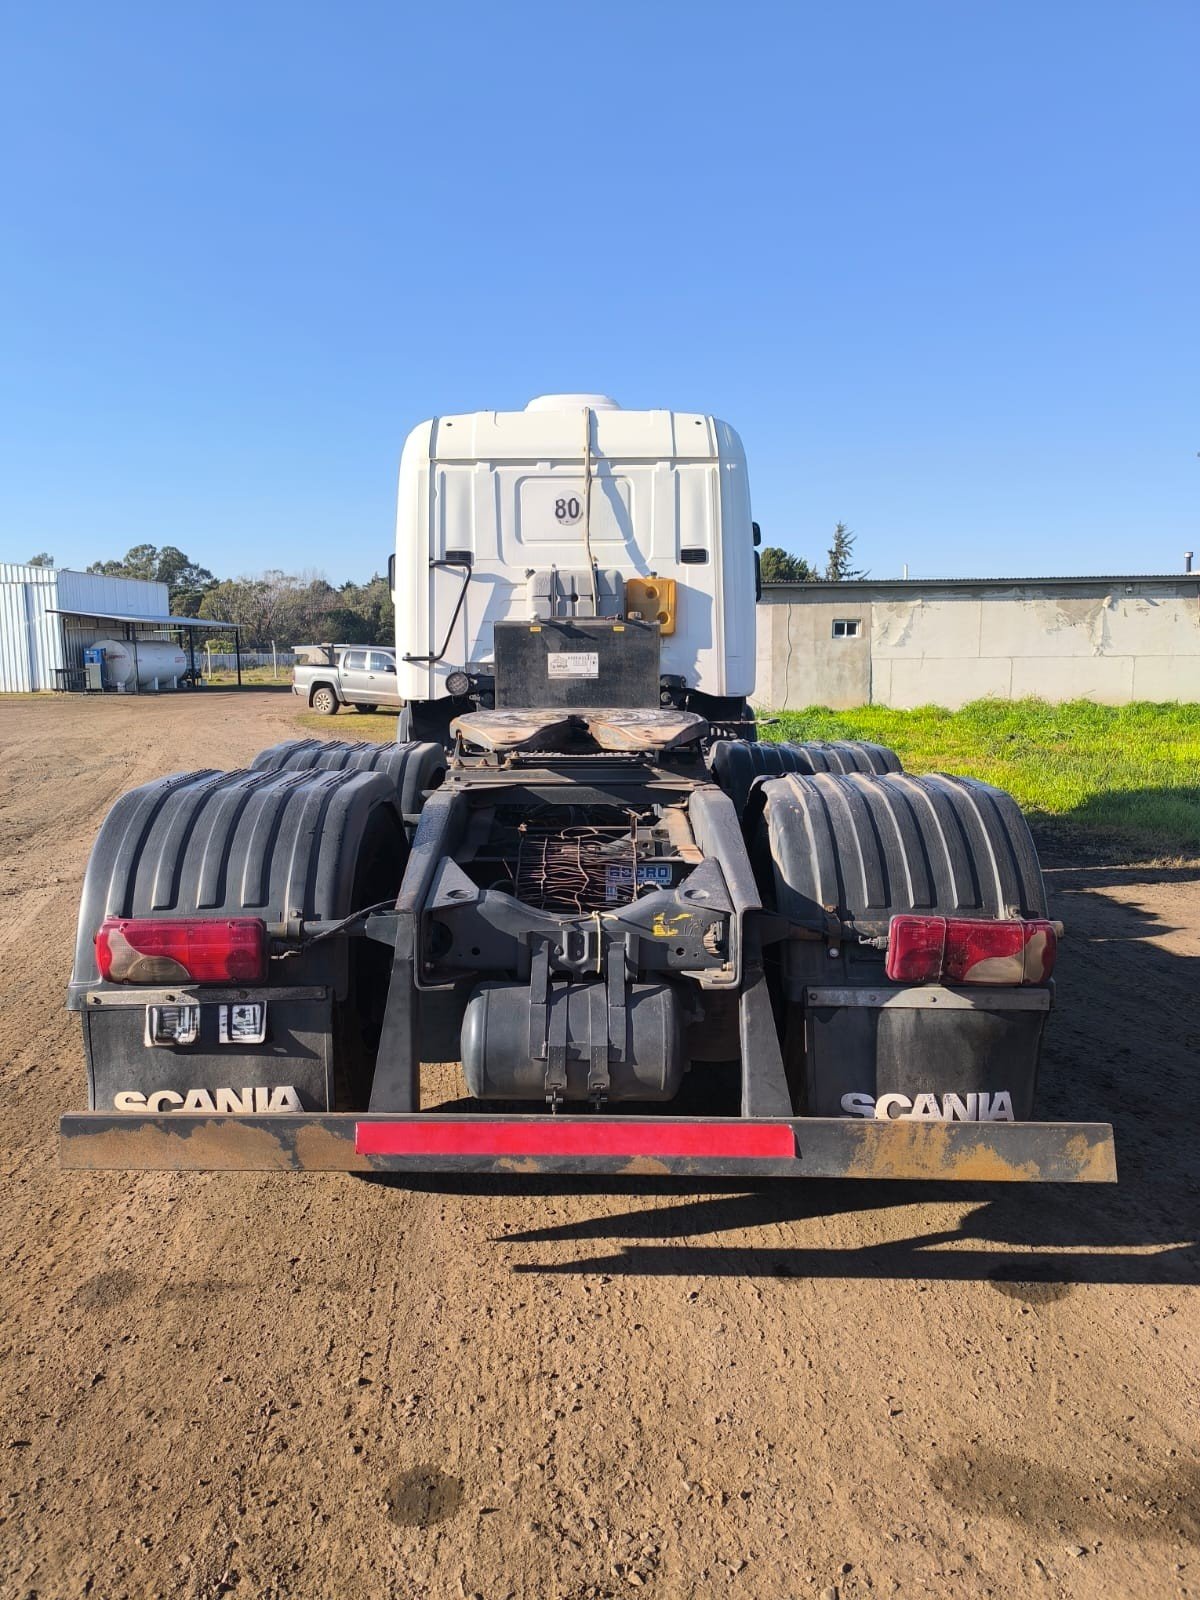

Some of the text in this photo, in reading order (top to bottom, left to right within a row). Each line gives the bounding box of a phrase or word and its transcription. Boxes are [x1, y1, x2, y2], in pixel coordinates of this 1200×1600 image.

[555, 498, 580, 519] 80
[114, 1085, 304, 1112] SCANIA
[840, 1091, 1015, 1121] SCANIA
